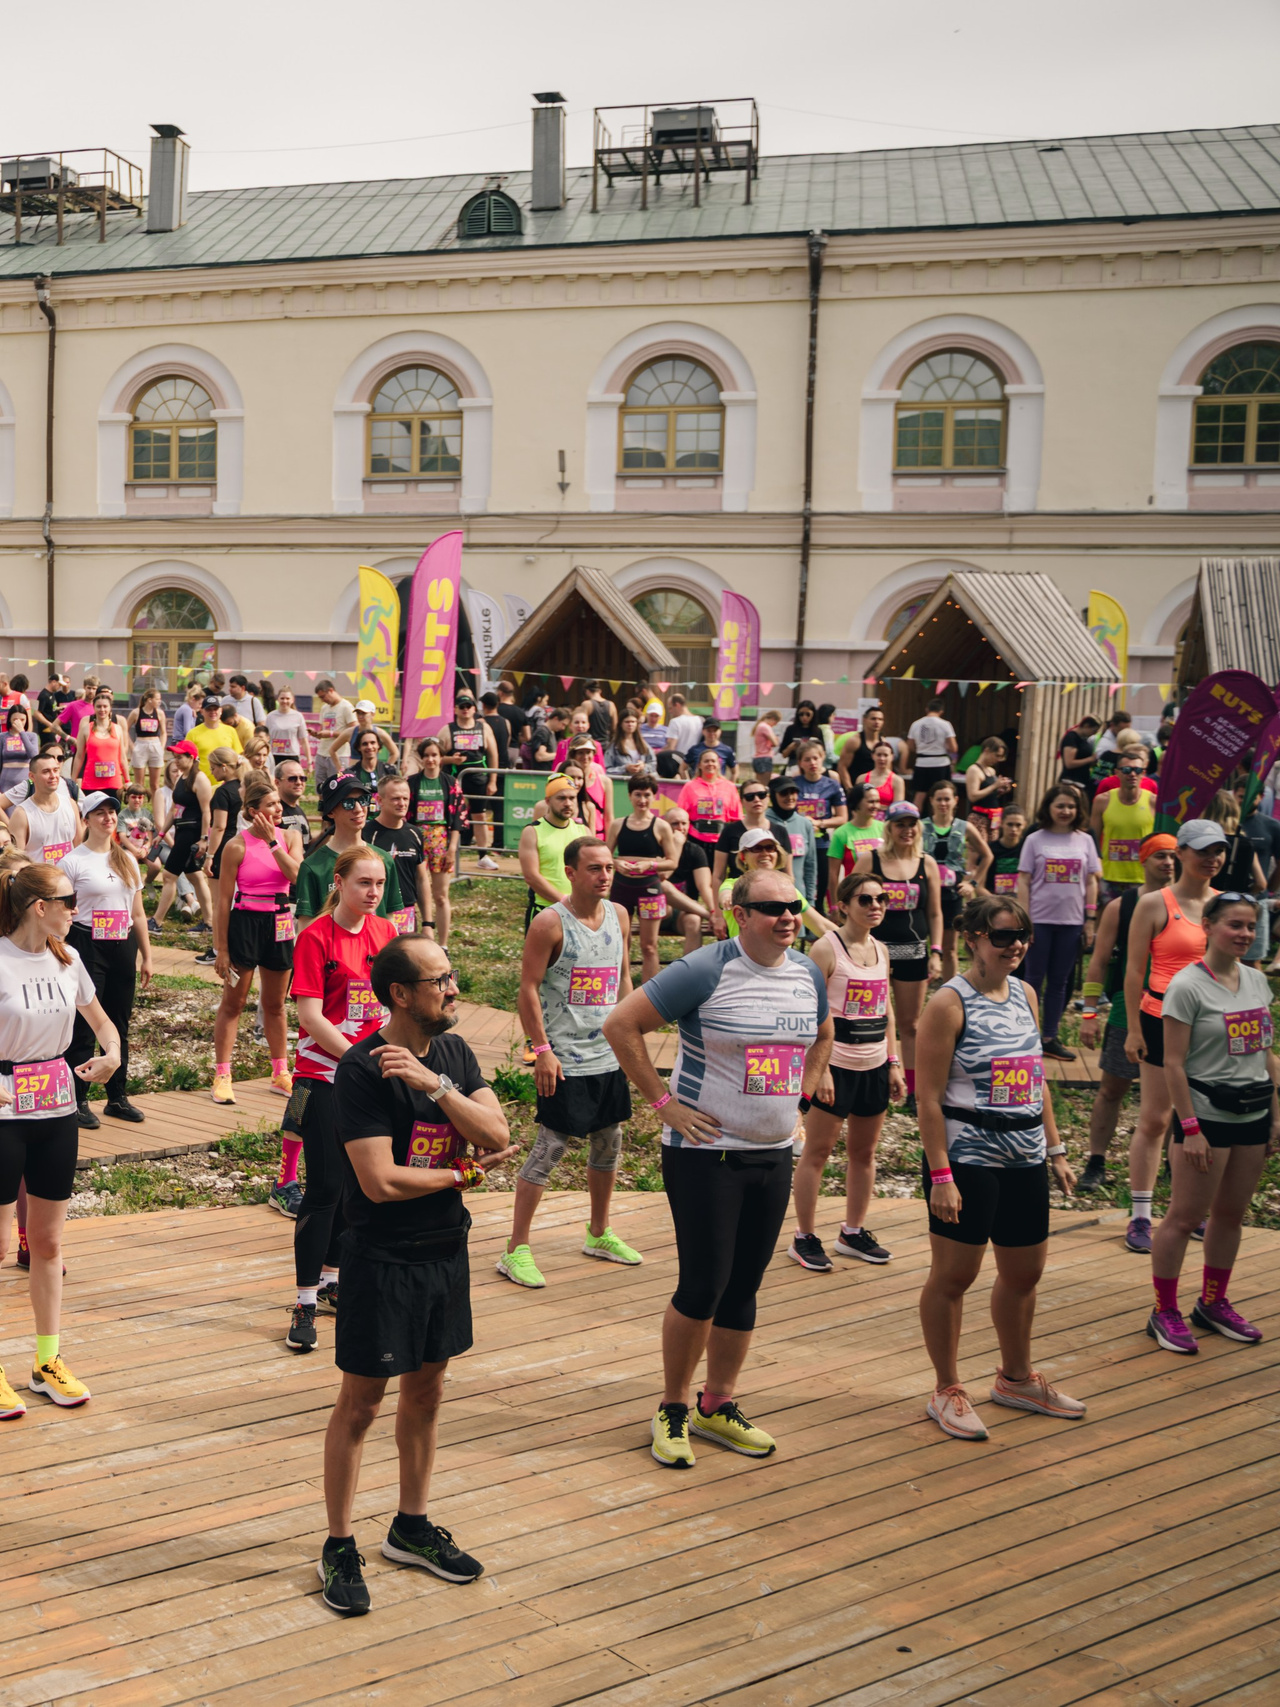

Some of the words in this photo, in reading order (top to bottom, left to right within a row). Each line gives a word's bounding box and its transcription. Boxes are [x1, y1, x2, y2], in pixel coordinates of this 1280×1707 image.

[415, 577, 454, 719] RUTS
[1209, 683, 1263, 724] RUTS
[1217, 716, 1250, 740] БЕЖИМ
[1188, 725, 1205, 737] ПО
[1201, 734, 1235, 758] ГОРОДУ
[1212, 730, 1240, 753] ТЕМПЕ
[1207, 763, 1224, 779] 3
[513, 782, 537, 790] RUTS
[44, 848, 63, 861] 093
[1047, 865, 1066, 873] 310
[882, 890, 905, 900] 00
[640, 903, 657, 911] 245
[93, 918, 114, 928] 187
[276, 920, 291, 932] 371
[571, 978, 602, 991] 226
[22, 982, 67, 1009] RUN
[847, 989, 873, 1002] 179
[1228, 1021, 1260, 1038] 003
[747, 1059, 780, 1075] 241
[16, 1075, 50, 1094] 257
[992, 1070, 1028, 1086] 240
[416, 1125, 437, 1133] RUTS
[412, 1138, 451, 1156] 051
